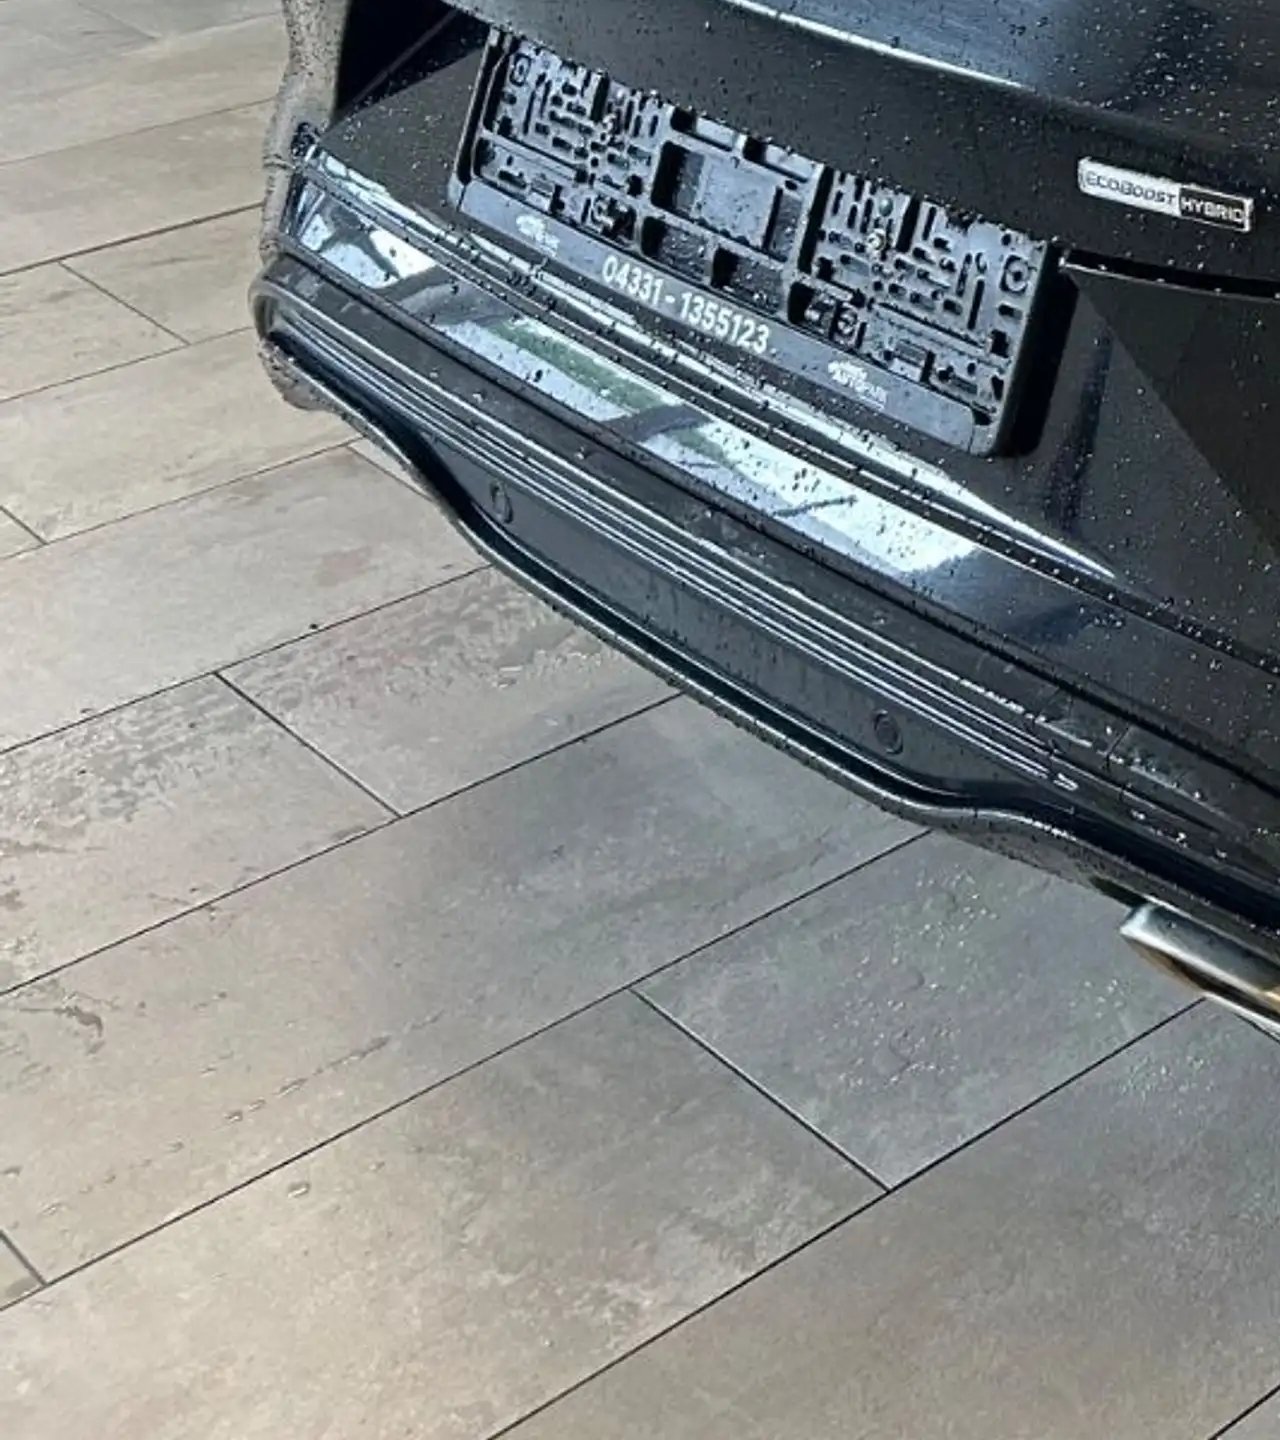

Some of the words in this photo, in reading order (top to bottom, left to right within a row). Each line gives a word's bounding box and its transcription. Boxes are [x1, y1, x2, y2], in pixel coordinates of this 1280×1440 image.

[1180, 195, 1246, 224] HYBRID
[602, 254, 664, 306] 04331
[679, 291, 770, 354] 1355123
